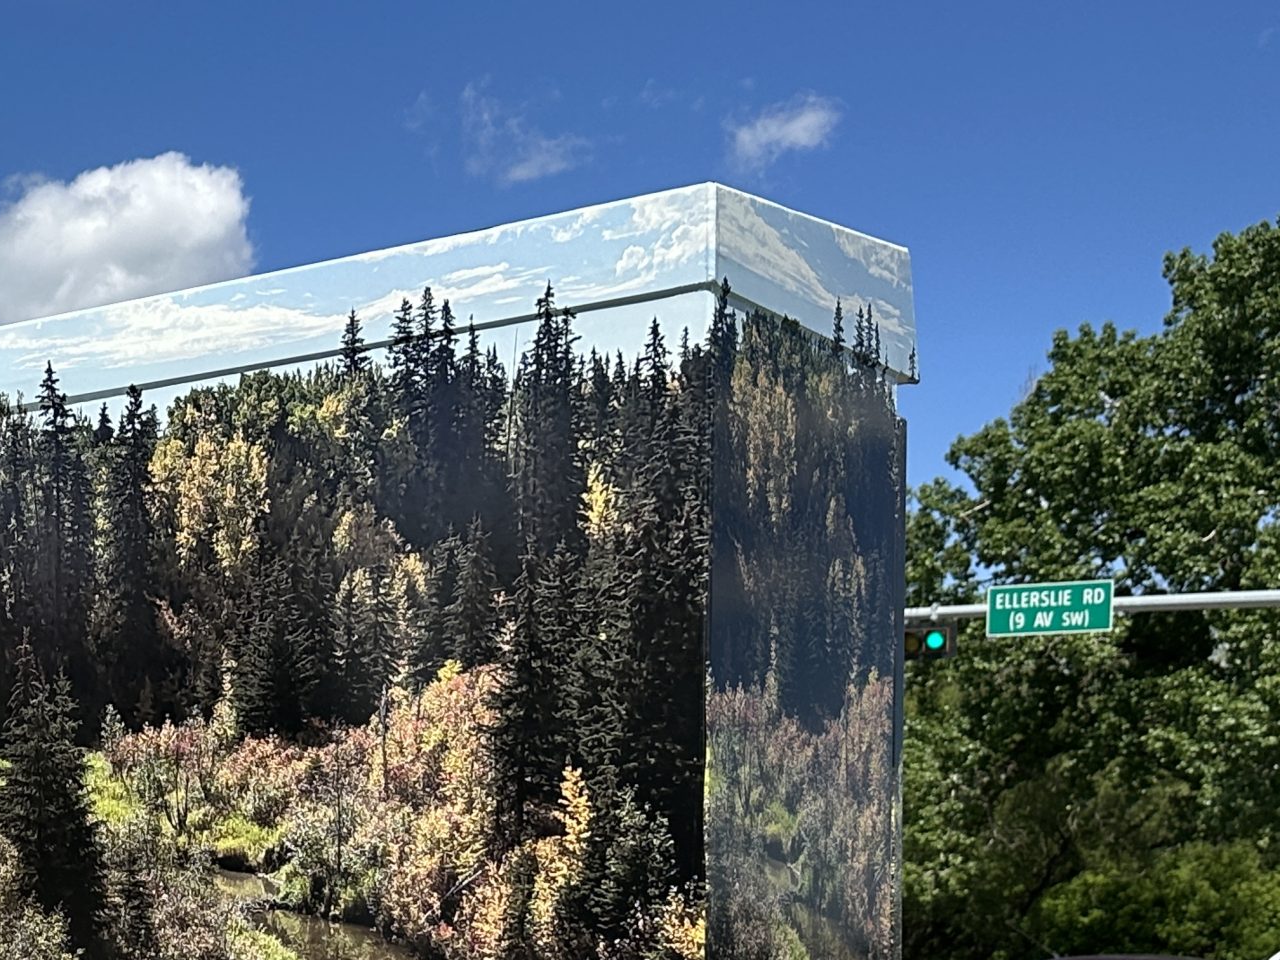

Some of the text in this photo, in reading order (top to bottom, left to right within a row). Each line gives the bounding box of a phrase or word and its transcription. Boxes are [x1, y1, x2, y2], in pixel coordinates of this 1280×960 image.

[995, 587, 1105, 609] ELLERSLIE RD
[1009, 609, 1089, 631] (9 AV SW)
